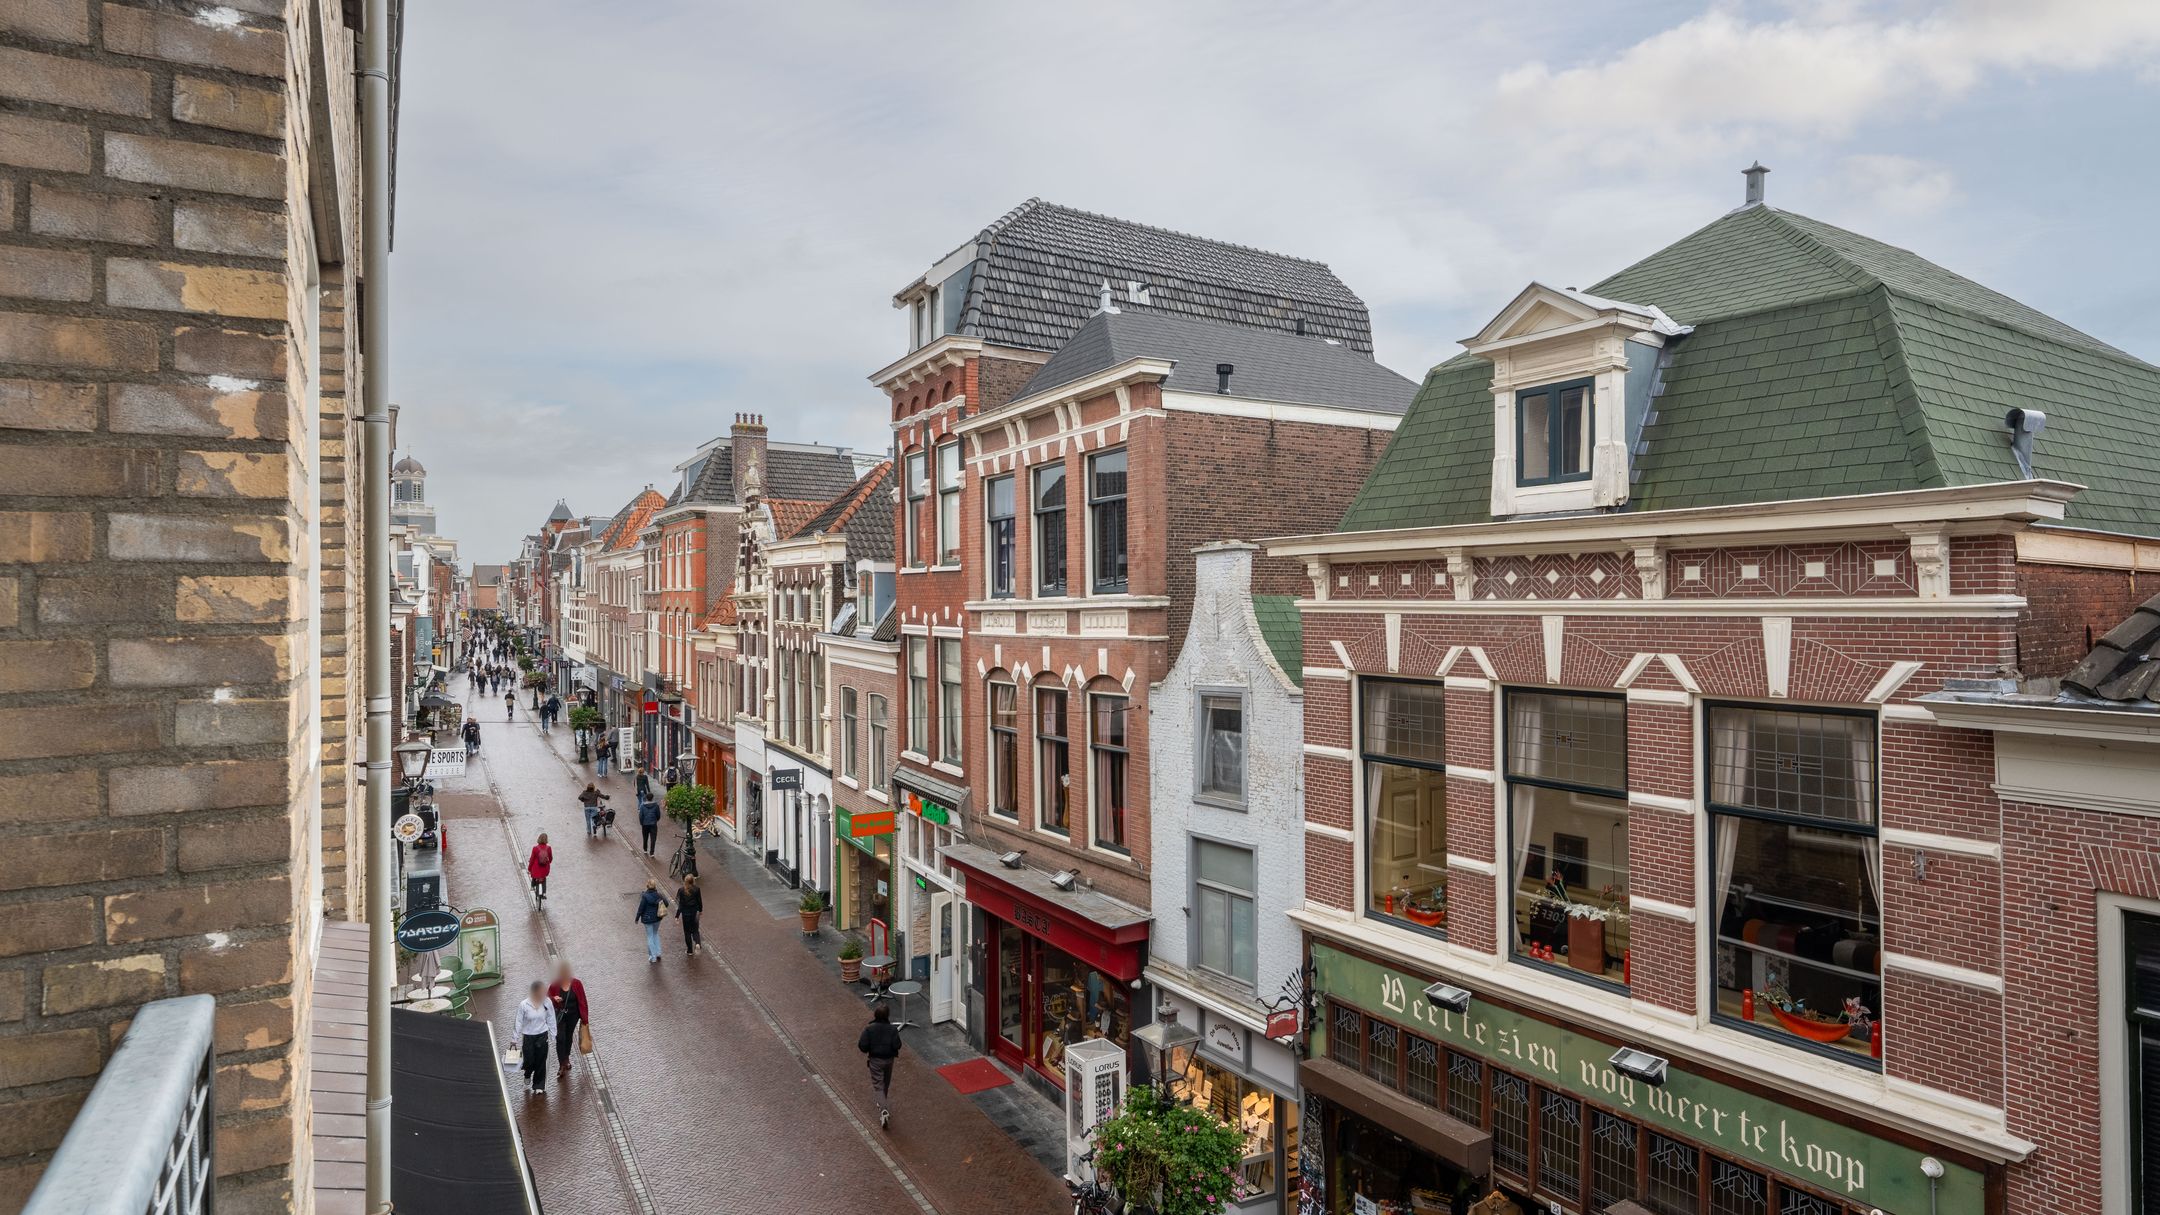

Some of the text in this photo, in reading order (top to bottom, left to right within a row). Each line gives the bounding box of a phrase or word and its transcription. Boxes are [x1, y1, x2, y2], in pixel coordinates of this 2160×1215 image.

[437, 751, 464, 763] SPORTS
[775, 775, 797, 784] CECIL
[1067, 1056, 1120, 1073] LORUS LORUS
[1463, 1011, 1487, 1045] te
[1498, 1028, 1559, 1074] zien
[1580, 1059, 1636, 1108] nog
[1647, 1084, 1729, 1136] meer
[1738, 1110, 1768, 1153] te
[1779, 1119, 1864, 1193] koop
